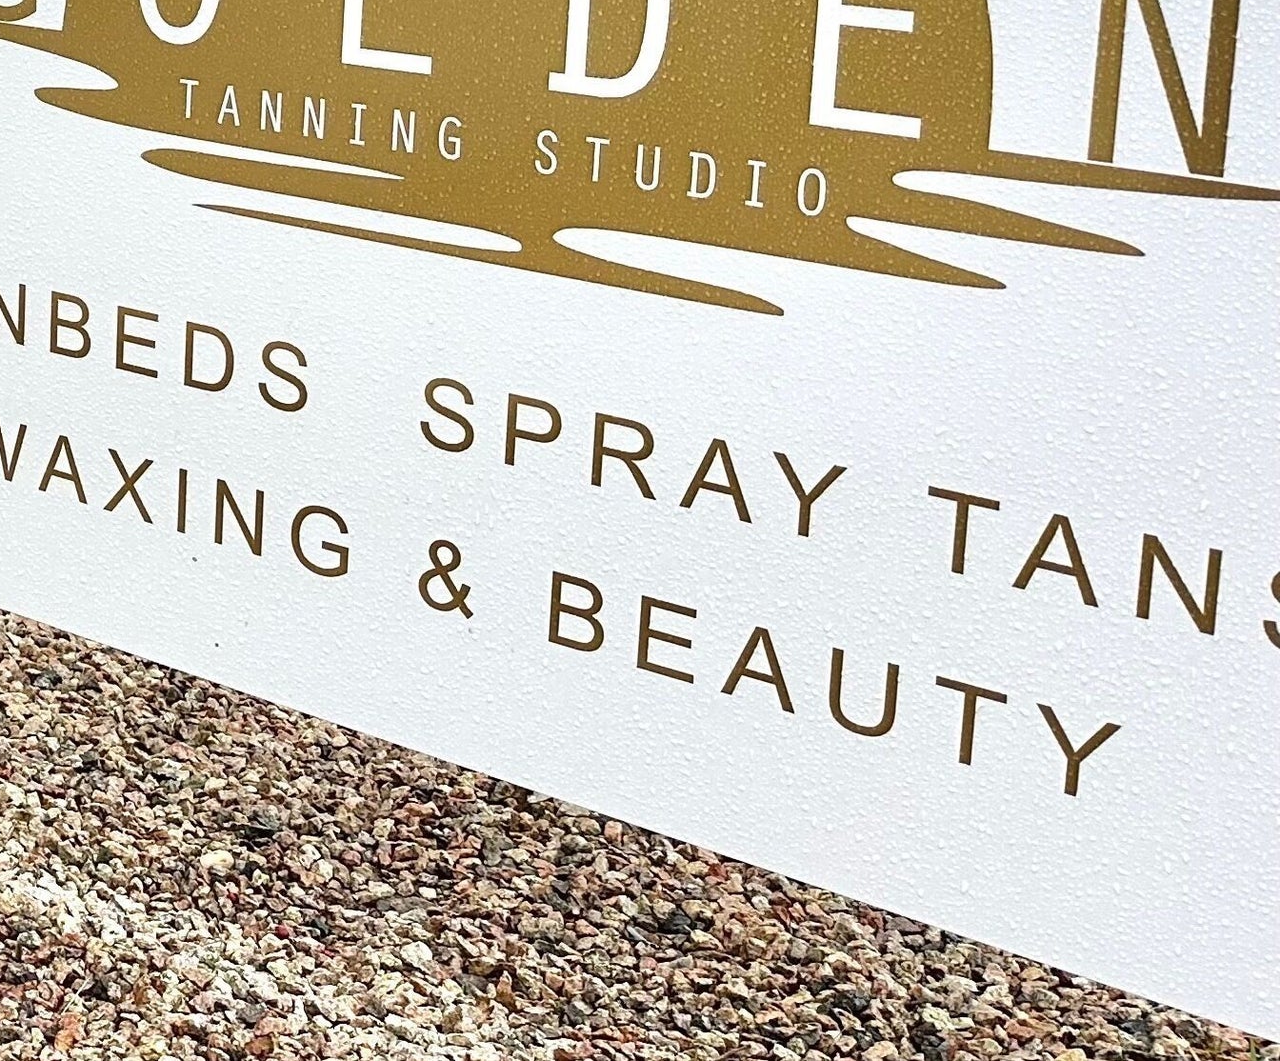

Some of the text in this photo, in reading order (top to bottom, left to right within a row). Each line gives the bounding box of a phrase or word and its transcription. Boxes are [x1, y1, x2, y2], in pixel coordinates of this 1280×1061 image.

[179, 78, 828, 218] TANNING STUDIO
[419, 377, 847, 538] SPRAY
[417, 539, 474, 619] &
[546, 571, 1122, 797] BEAUTY
